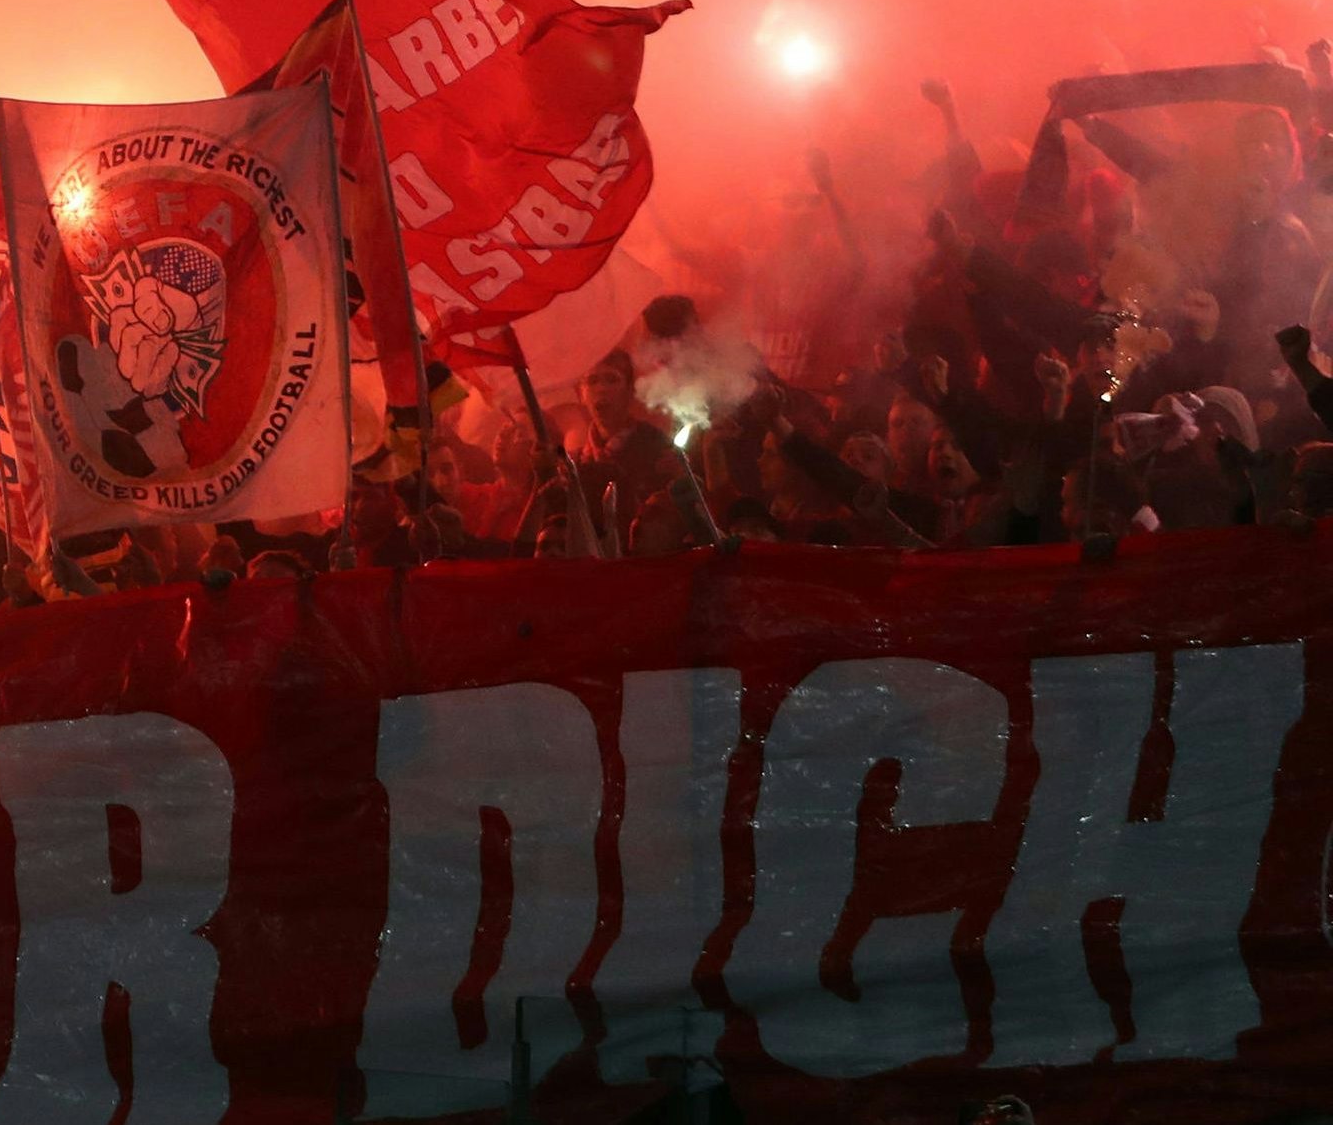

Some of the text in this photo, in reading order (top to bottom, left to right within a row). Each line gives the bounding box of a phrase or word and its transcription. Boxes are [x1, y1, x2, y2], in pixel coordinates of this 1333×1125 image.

[33, 224, 51, 270] WE
[97, 135, 174, 175] ABOUT
[180, 137, 220, 170] THE
[225, 153, 305, 241] RICHEST
[75, 191, 235, 271] UEFA
[39, 375, 72, 454] YOUR
[69, 452, 149, 500] GREED
[155, 483, 218, 510] KILLS
[251, 322, 317, 461] FOOTBALL
[348, 642, 1306, 1120] DICH
